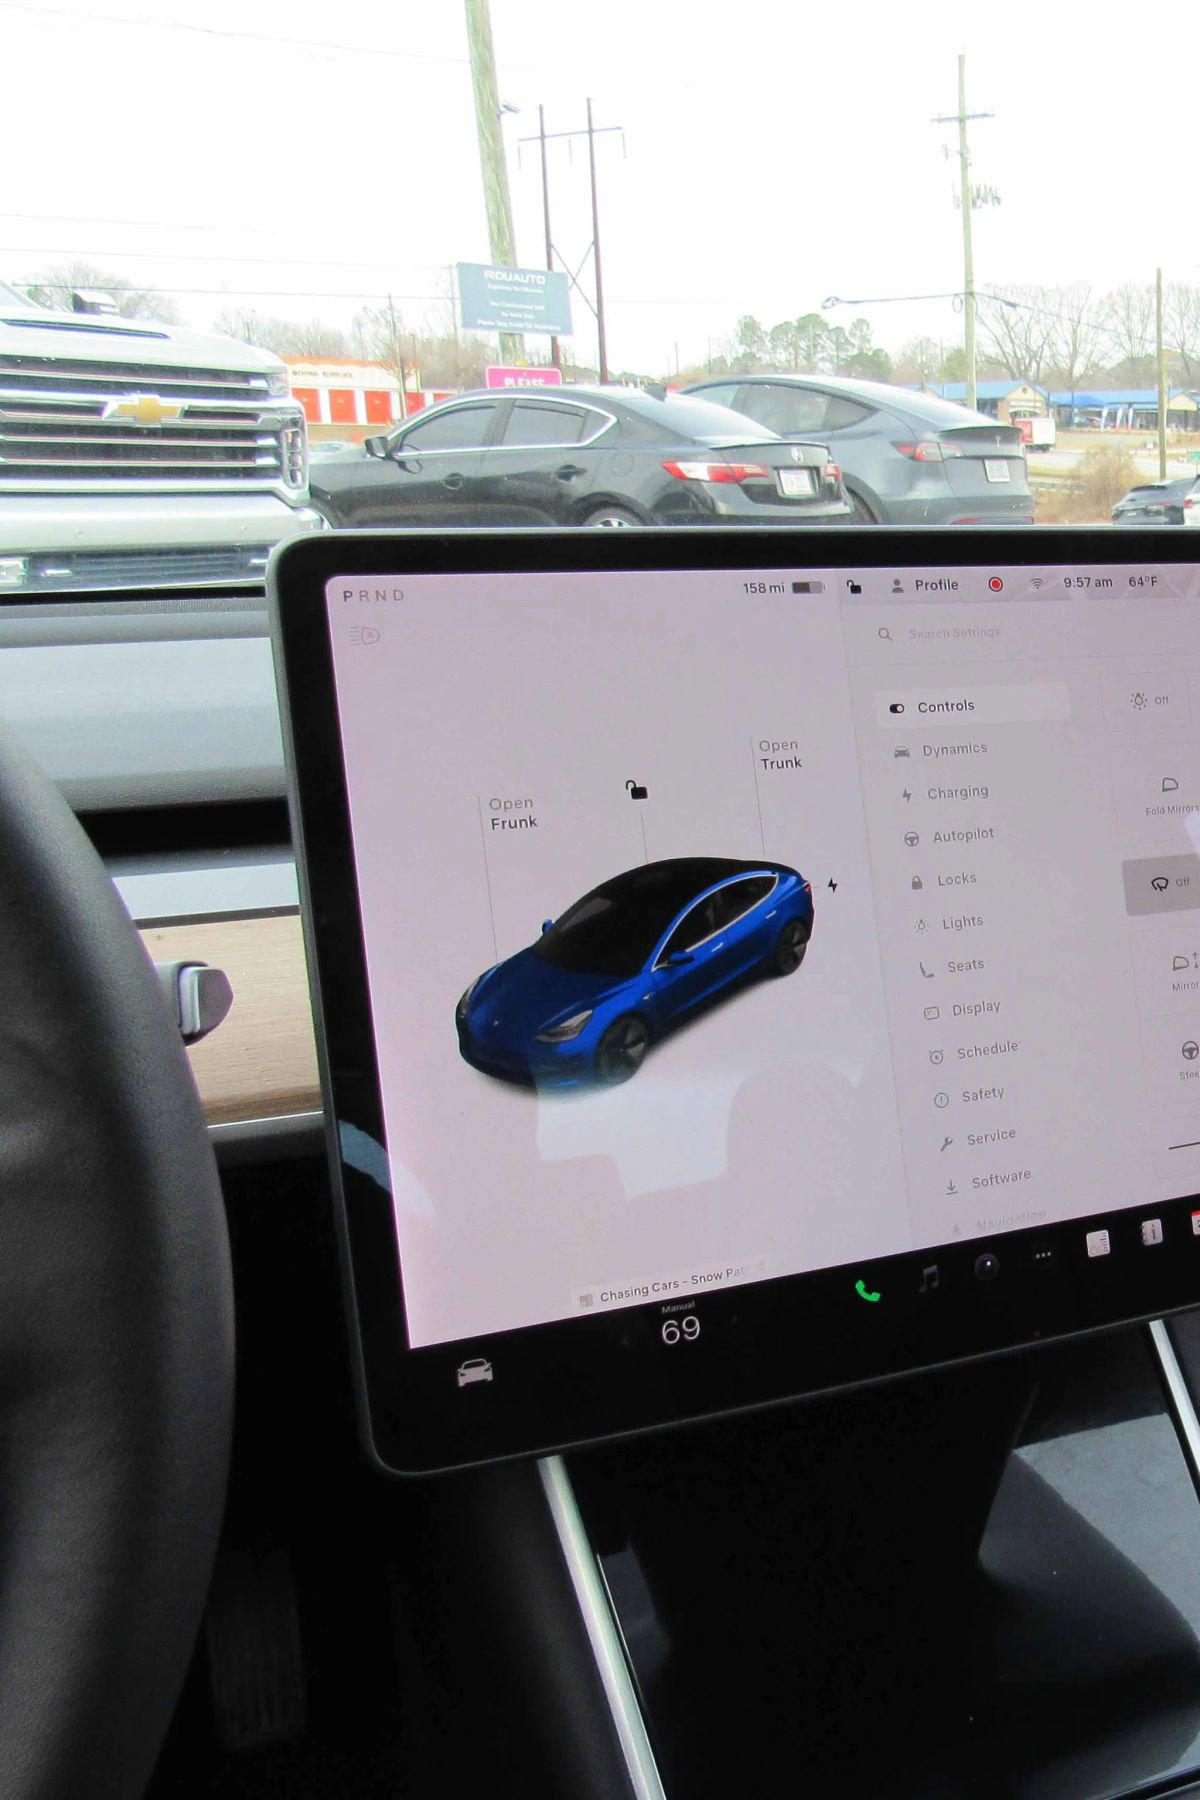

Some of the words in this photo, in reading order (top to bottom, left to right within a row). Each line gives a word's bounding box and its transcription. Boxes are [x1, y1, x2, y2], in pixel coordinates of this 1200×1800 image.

[743, 582, 767, 594] 158
[769, 581, 785, 594] mi
[915, 579, 959, 591] Profile
[1063, 577, 1091, 589] 9:57
[1094, 579, 1113, 588] am
[908, 628, 950, 640] Search
[917, 699, 975, 714] Controls
[1154, 695, 1169, 705] Off
[759, 740, 799, 754] Open
[922, 742, 988, 759] Dynamics
[760, 756, 803, 770] Trunk
[927, 785, 989, 800] Charging
[489, 798, 534, 813] Open
[1145, 806, 1166, 816] Fold
[1167, 804, 1200, 815] Mirrors
[491, 814, 538, 831] Frunk
[933, 827, 995, 843] Autopilot
[937, 872, 977, 887] Locks
[1175, 876, 1190, 888] Off
[942, 915, 984, 931] Lights
[947, 959, 985, 973] Seats
[952, 1000, 1001, 1016] Display
[957, 1040, 1019, 1059] Schedule
[962, 1087, 1005, 1102] Safety
[967, 1129, 1016, 1145] Service
[971, 1169, 1032, 1189] Software
[600, 1284, 649, 1302] Chasing
[651, 1279, 680, 1293] Cars
[691, 1271, 723, 1285] Snow
[661, 1300, 696, 1314] Manual
[661, 1315, 701, 1344] 69
